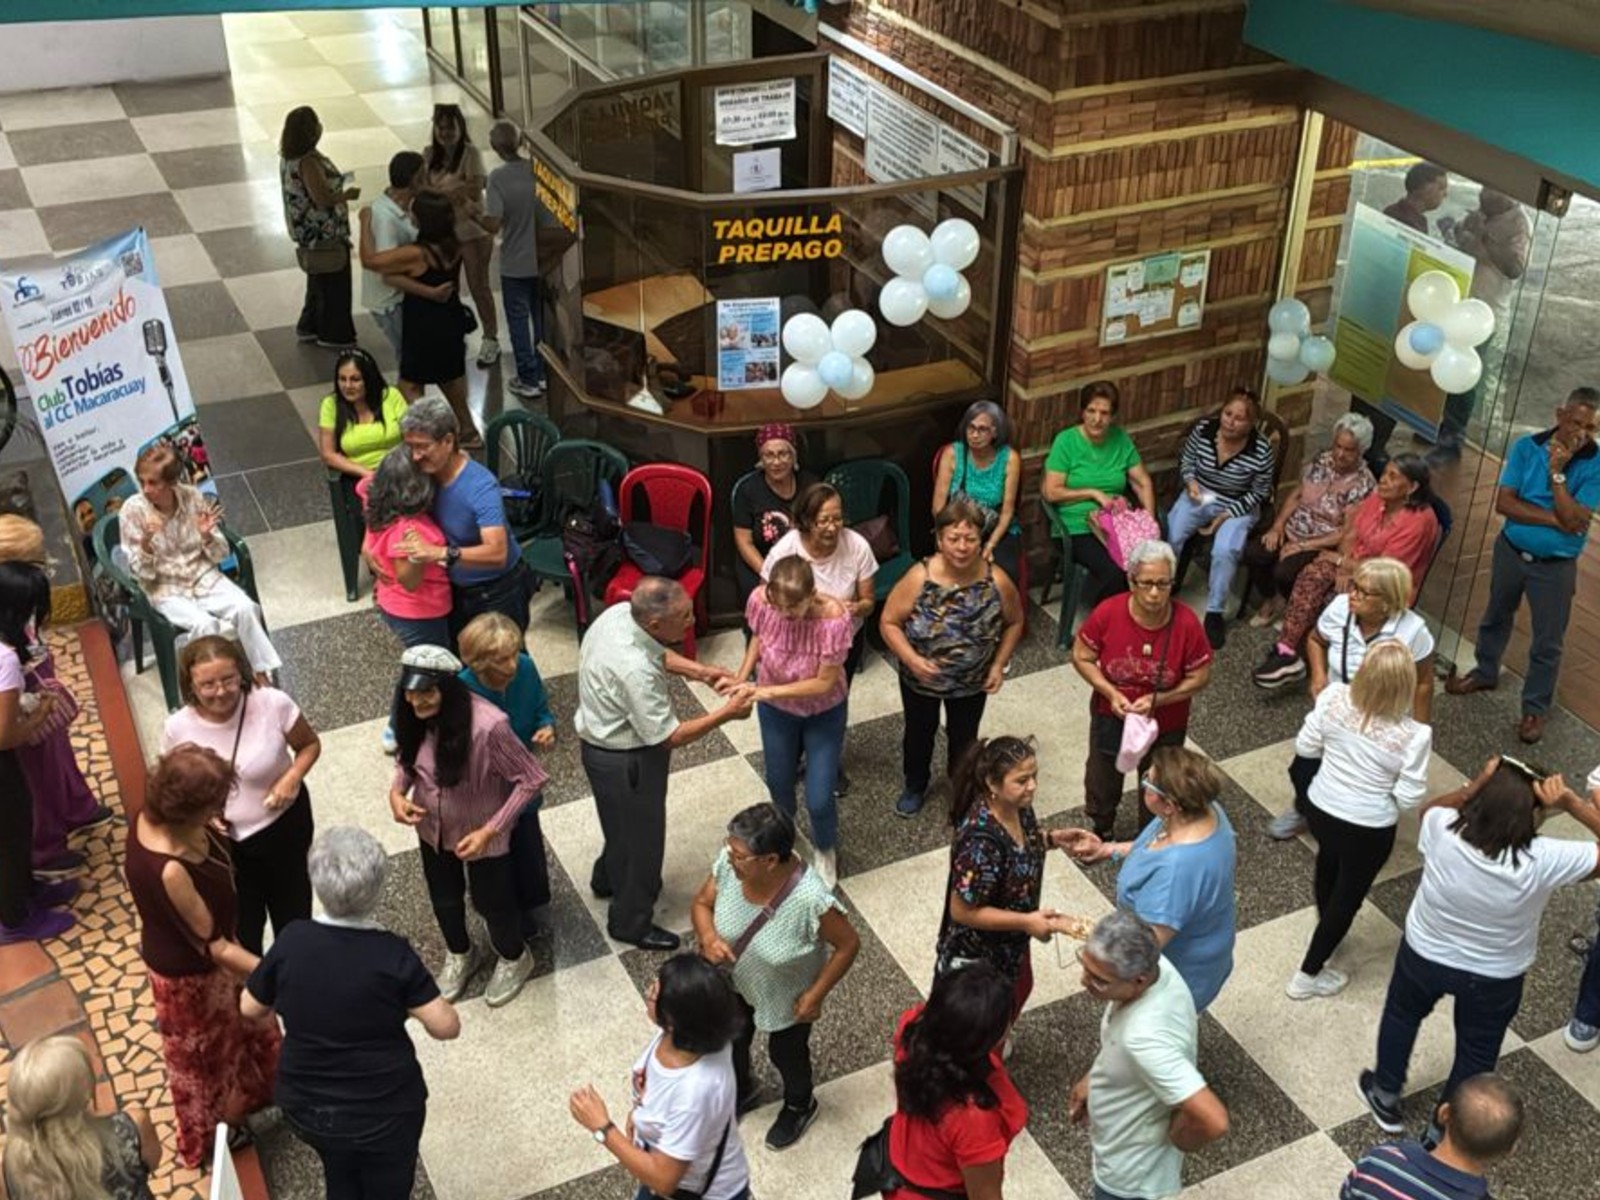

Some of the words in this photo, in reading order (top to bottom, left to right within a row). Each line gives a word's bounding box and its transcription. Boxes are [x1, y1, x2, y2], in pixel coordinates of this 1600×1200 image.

[532, 155, 576, 209] TAQUILLA
[535, 181, 577, 233] PREPAGO
[712, 212, 843, 240] TAQUILLA
[717, 238, 843, 264] PREPAGO
[30, 286, 136, 381] Bienvenido
[37, 387, 66, 412] Club
[61, 362, 124, 400] Tobías
[43, 411, 55, 430] al
[55, 403, 74, 423] CC
[74, 376, 146, 414] Macaracuay
